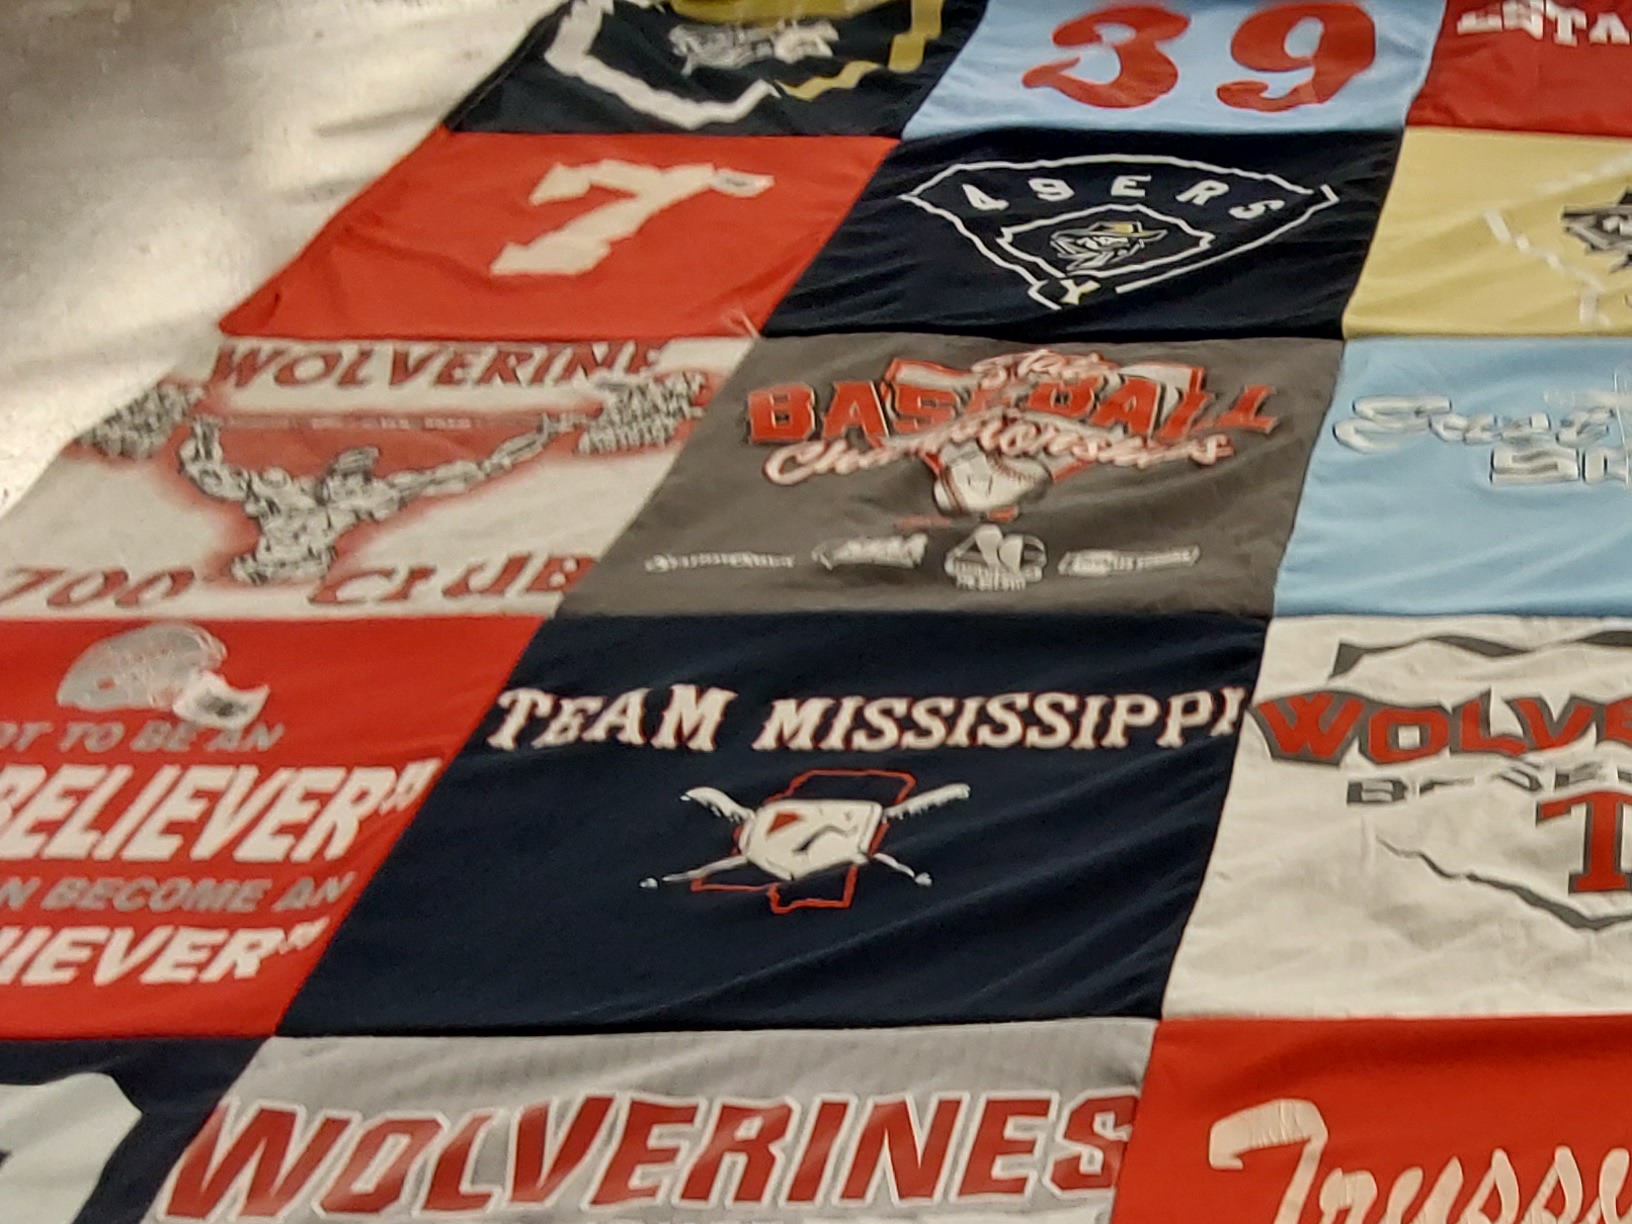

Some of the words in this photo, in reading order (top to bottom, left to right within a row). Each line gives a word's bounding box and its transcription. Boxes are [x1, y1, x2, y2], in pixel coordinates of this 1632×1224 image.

[1022, 3, 1377, 113] 39
[59, 721, 125, 753] TO
[131, 721, 207, 752] BE
[486, 683, 738, 752] TEAM
[751, 684, 1247, 751] MISSISSIPPI
[41, 876, 273, 913] BECOME
[272, 870, 357, 912] AN
[152, 1082, 1140, 1224] WOLVERINES
